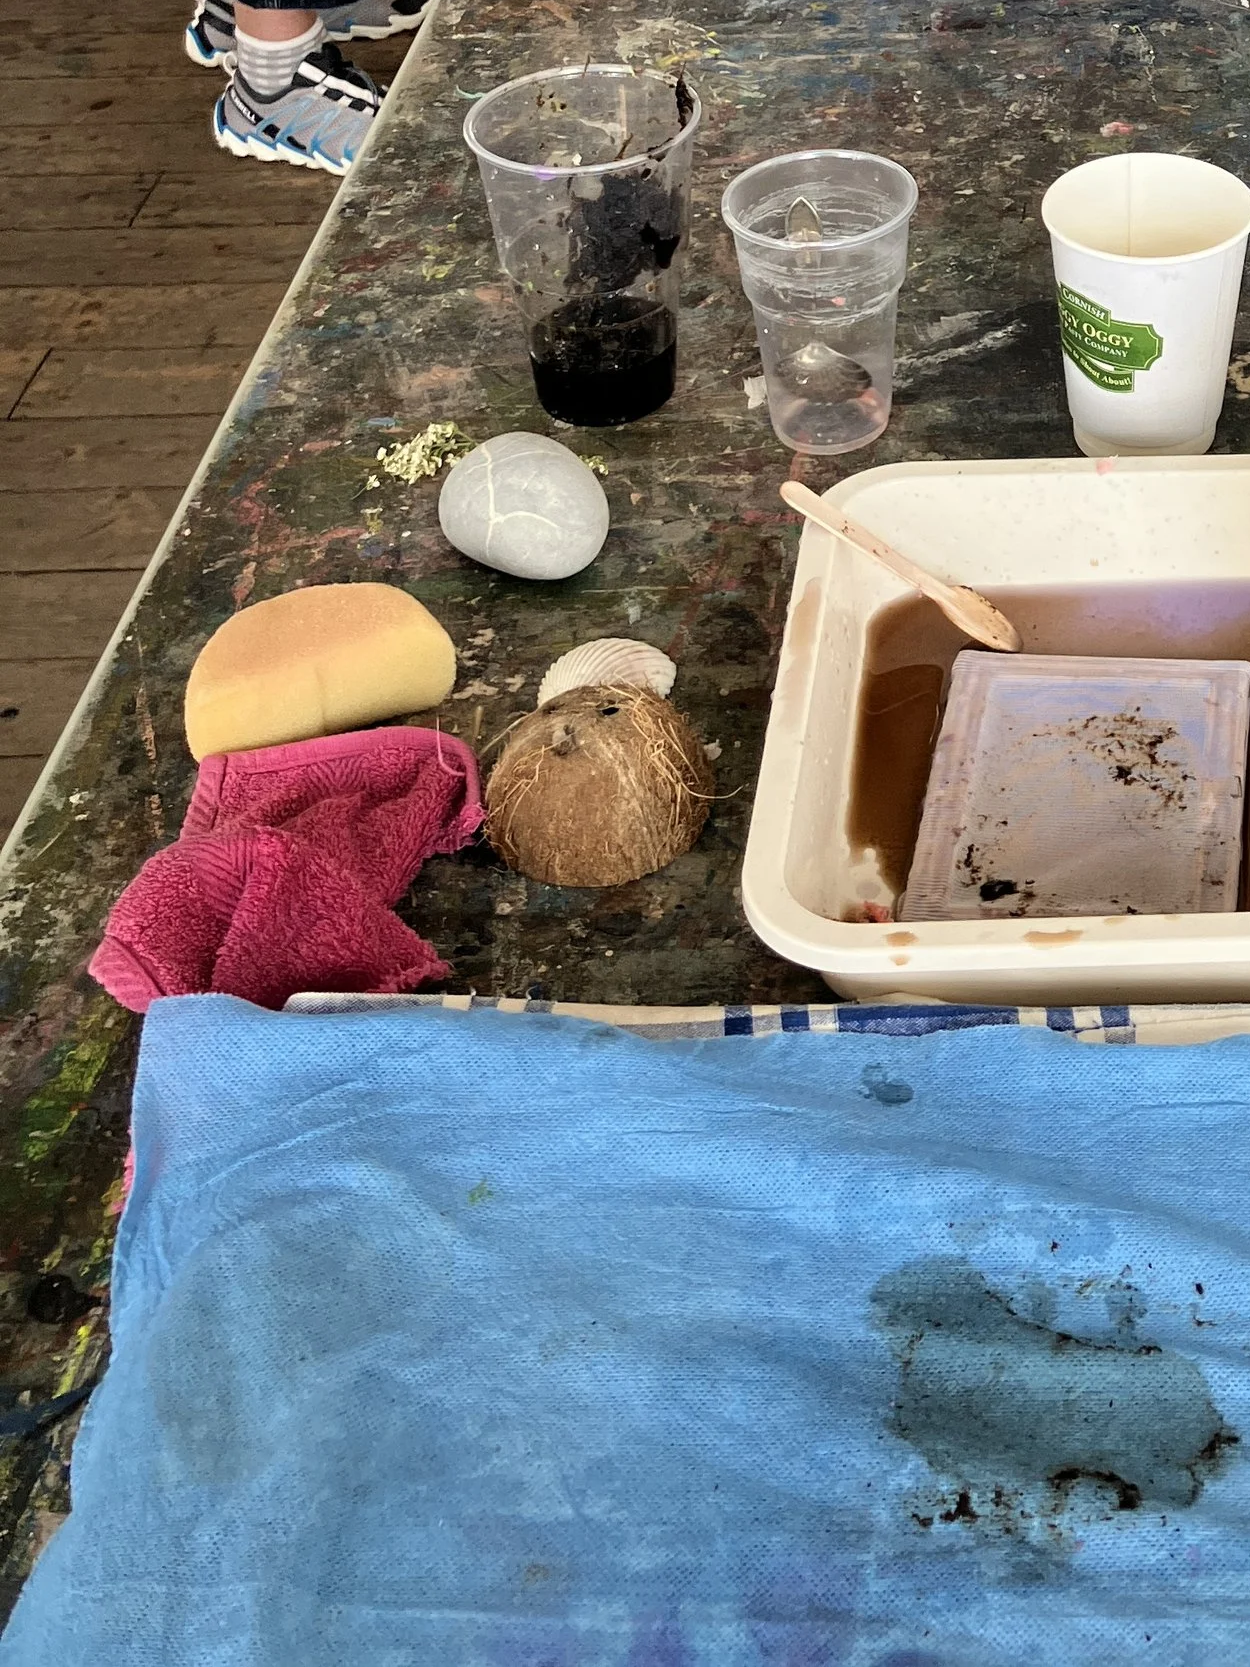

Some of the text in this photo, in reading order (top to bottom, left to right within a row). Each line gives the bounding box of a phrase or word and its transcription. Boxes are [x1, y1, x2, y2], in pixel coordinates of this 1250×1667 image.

[1062, 287, 1106, 321] CORNISH
[1082, 322, 1134, 349] OGGY
[1084, 336, 1128, 358] COMPANY
[1080, 355, 1101, 379] Shout
